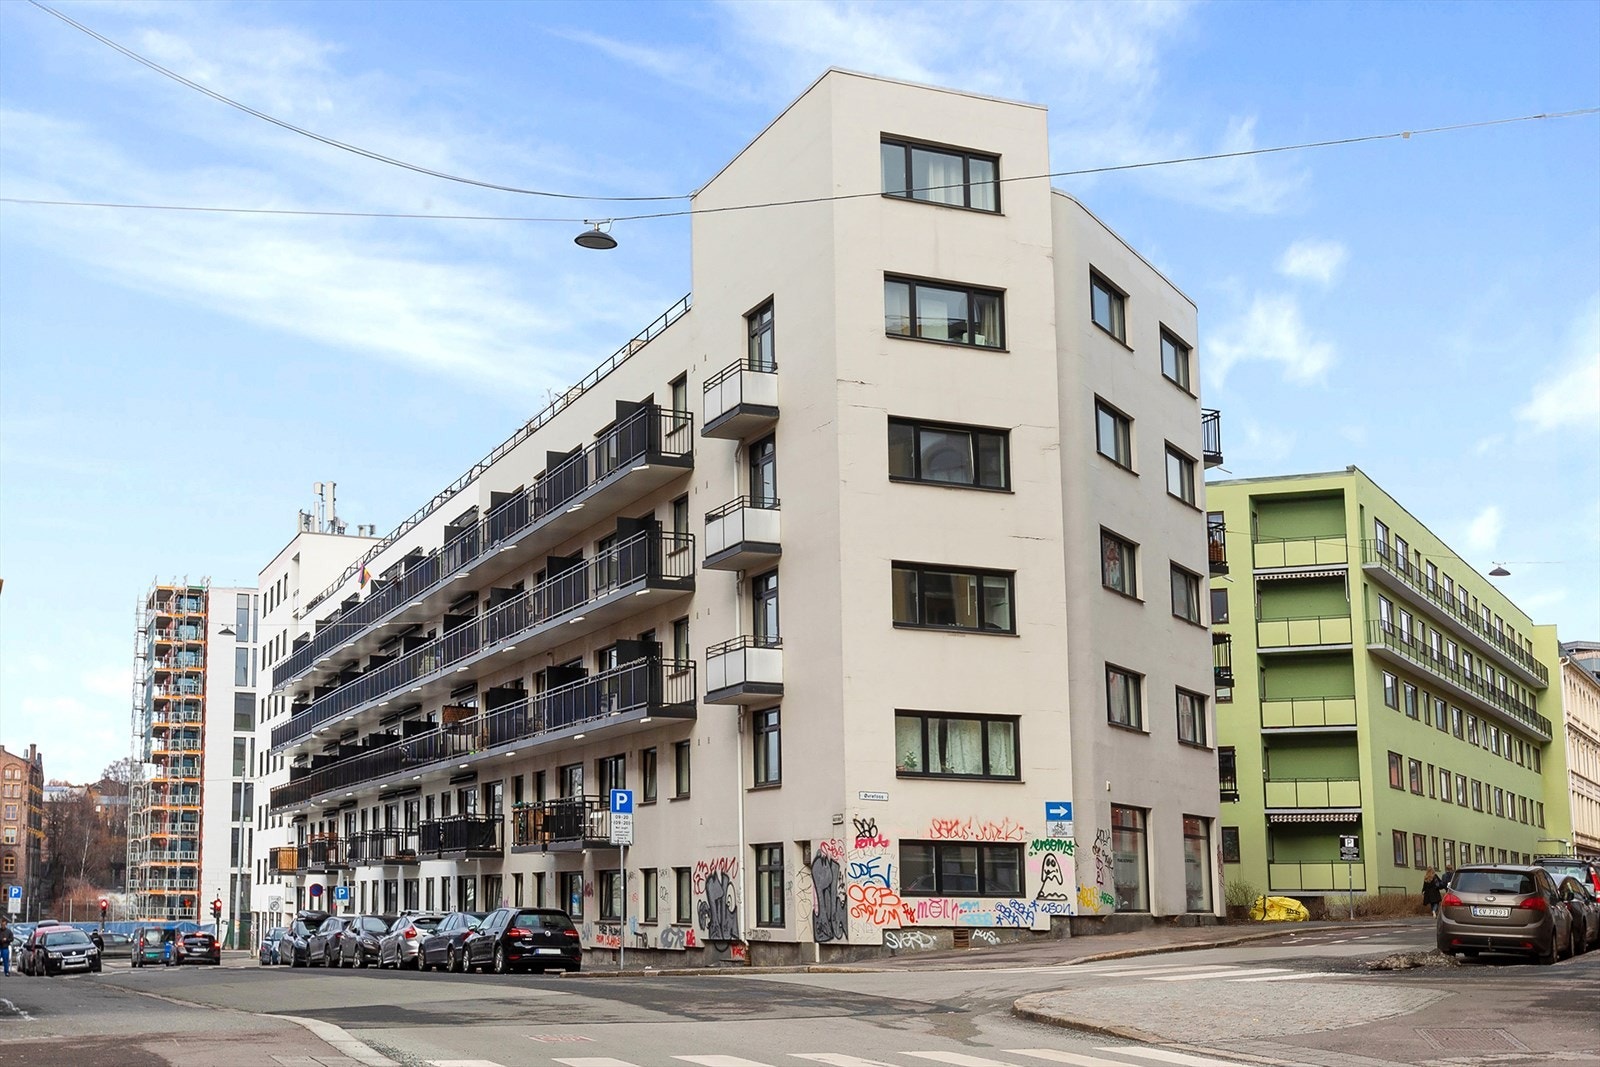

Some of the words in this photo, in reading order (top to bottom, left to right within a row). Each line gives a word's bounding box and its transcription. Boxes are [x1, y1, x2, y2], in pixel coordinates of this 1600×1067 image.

[616, 792, 628, 811] P
[11, 888, 19, 897] P
[338, 888, 346, 899] P
